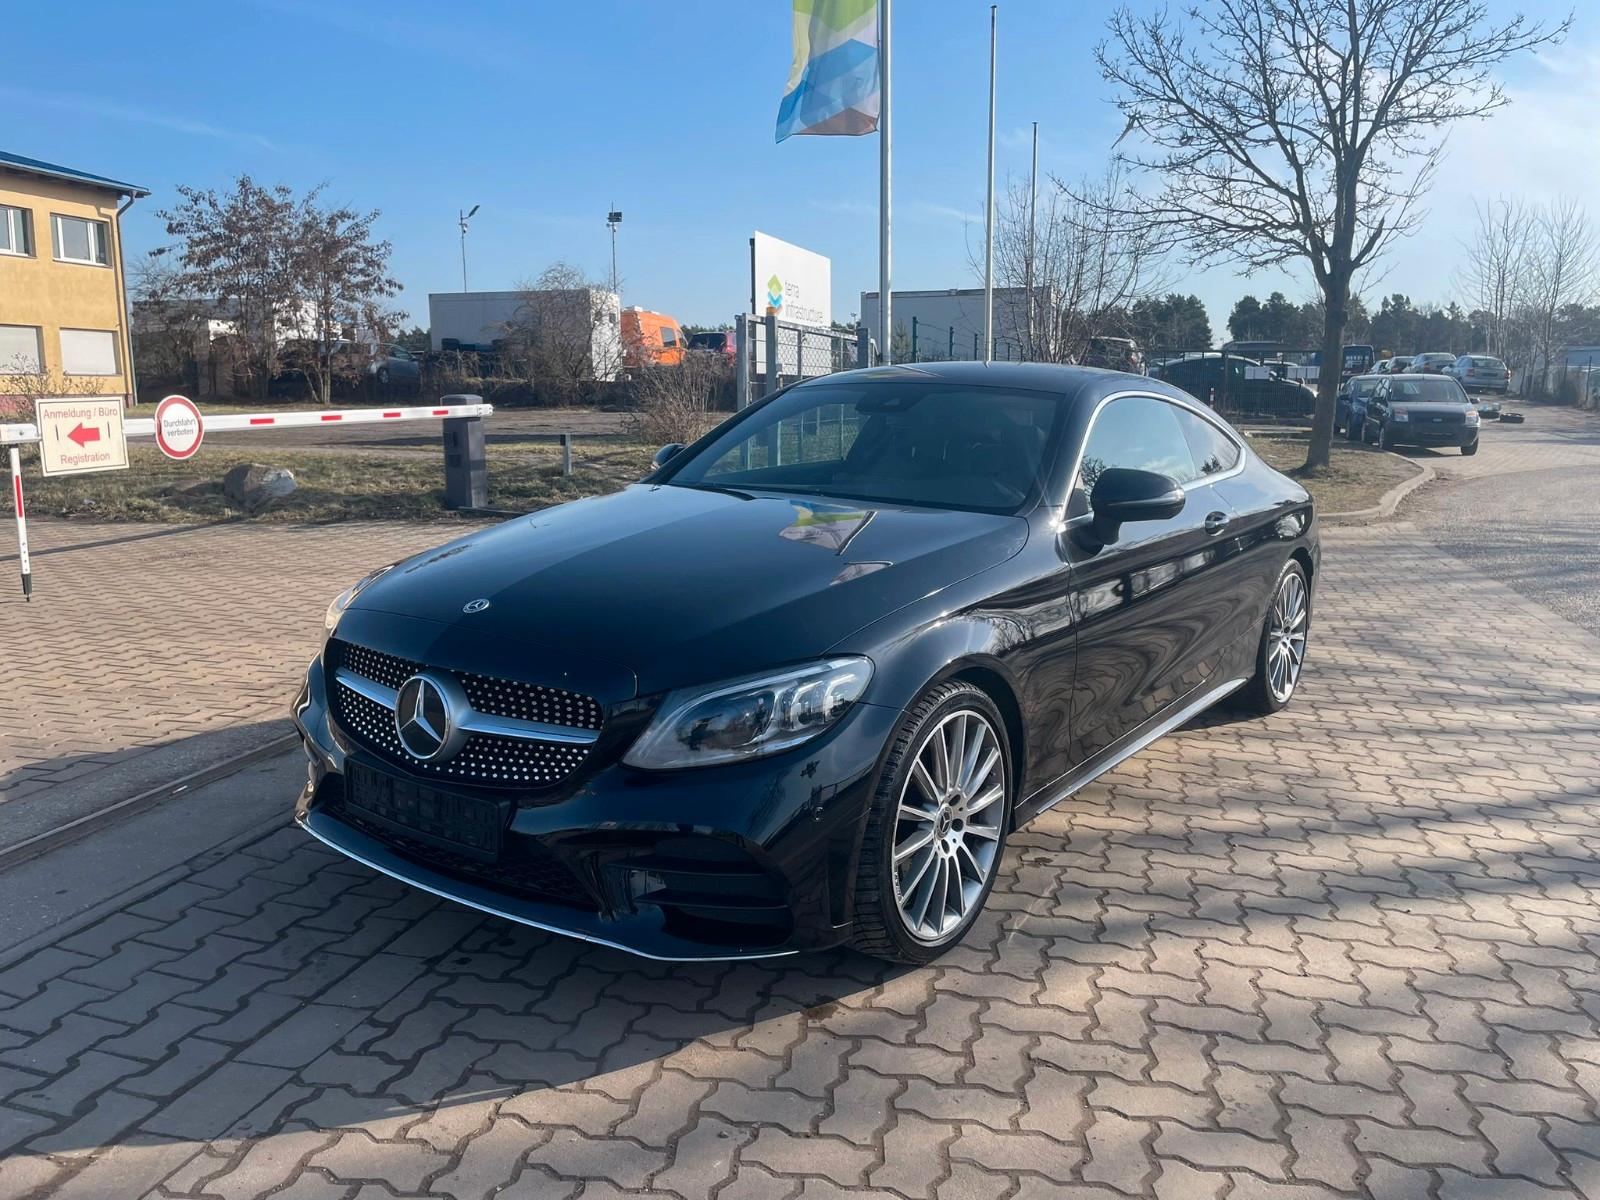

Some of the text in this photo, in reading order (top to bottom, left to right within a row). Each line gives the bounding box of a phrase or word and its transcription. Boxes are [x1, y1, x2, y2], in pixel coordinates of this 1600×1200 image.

[785, 281, 799, 298] terra
[43, 408, 92, 419] Anmeldung
[98, 406, 118, 416] Büro
[163, 418, 196, 427] Durchfahrt
[167, 428, 194, 436] verboten
[60, 452, 111, 465] Registration
